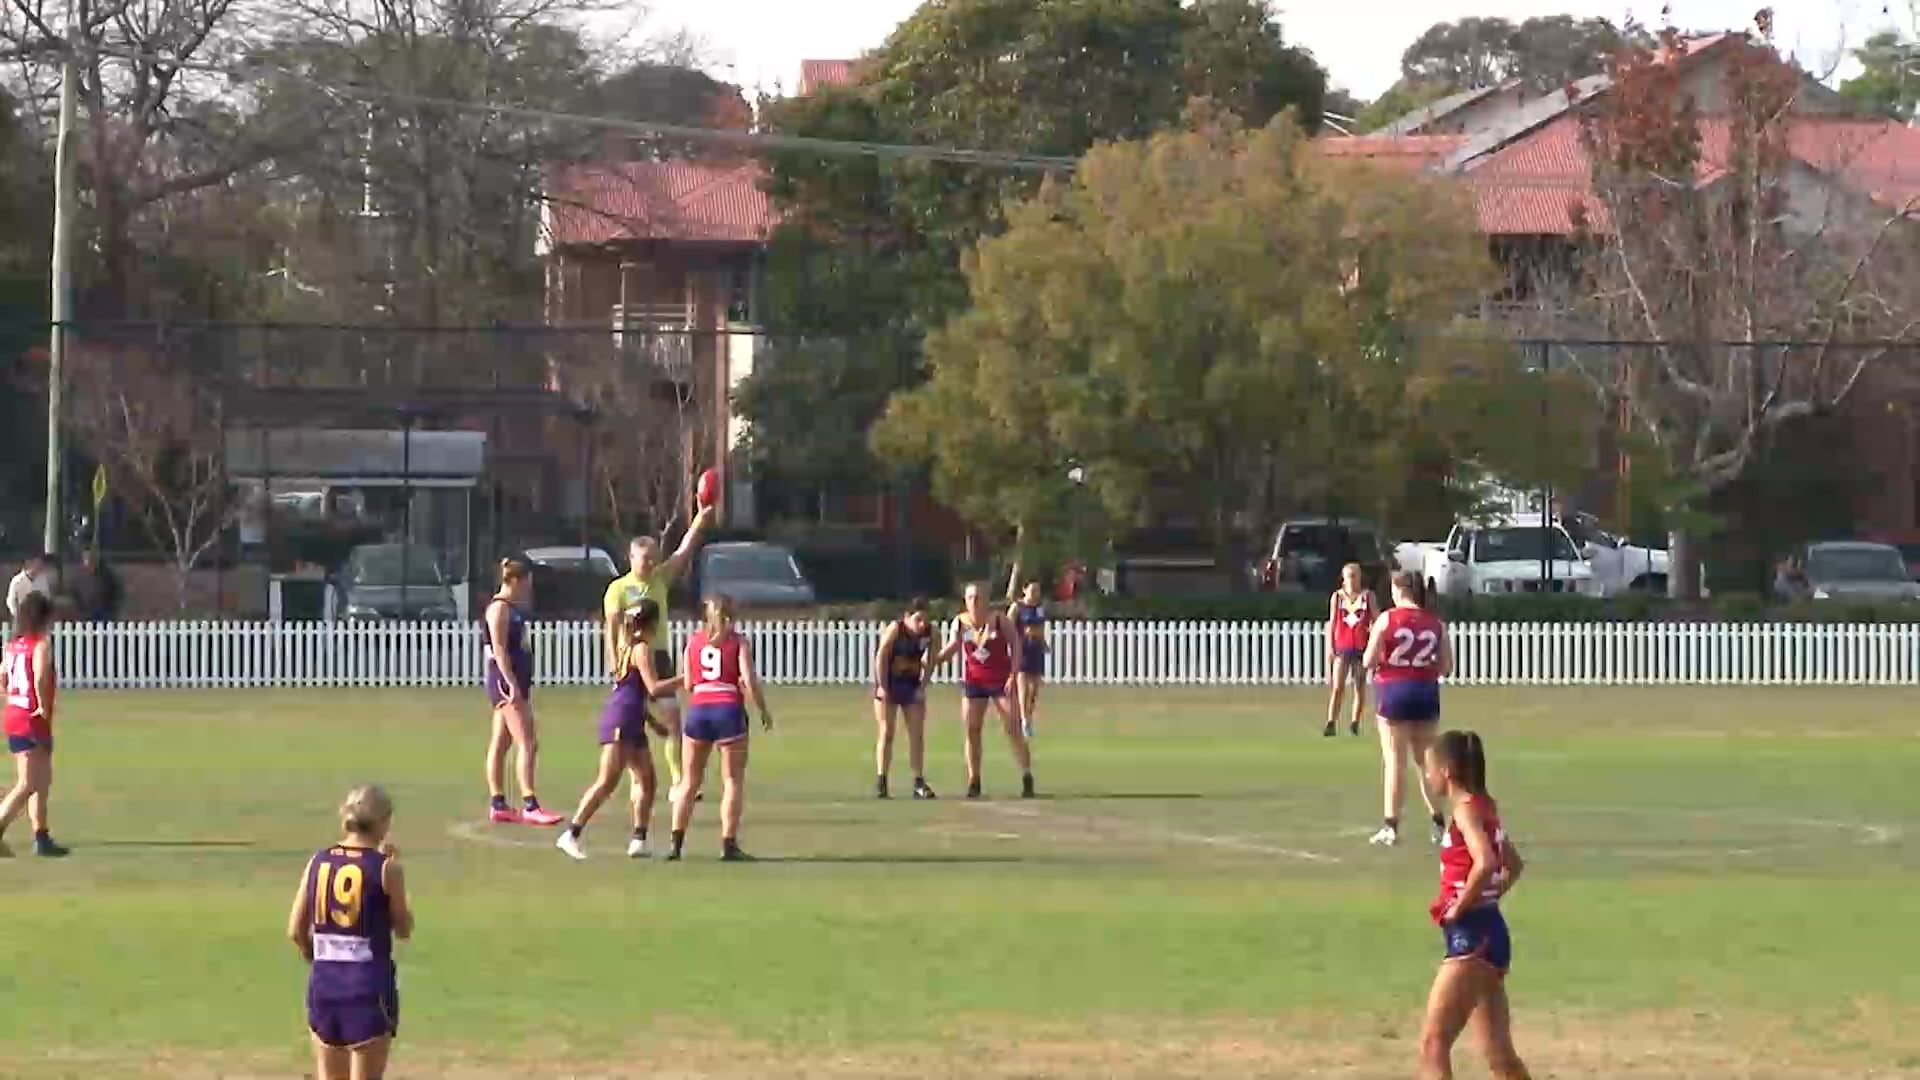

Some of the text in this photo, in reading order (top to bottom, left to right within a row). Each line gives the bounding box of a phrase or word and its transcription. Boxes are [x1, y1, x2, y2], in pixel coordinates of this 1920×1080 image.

[700, 645, 721, 681] 9
[1389, 628, 1437, 668] 22
[315, 863, 362, 928] 19
